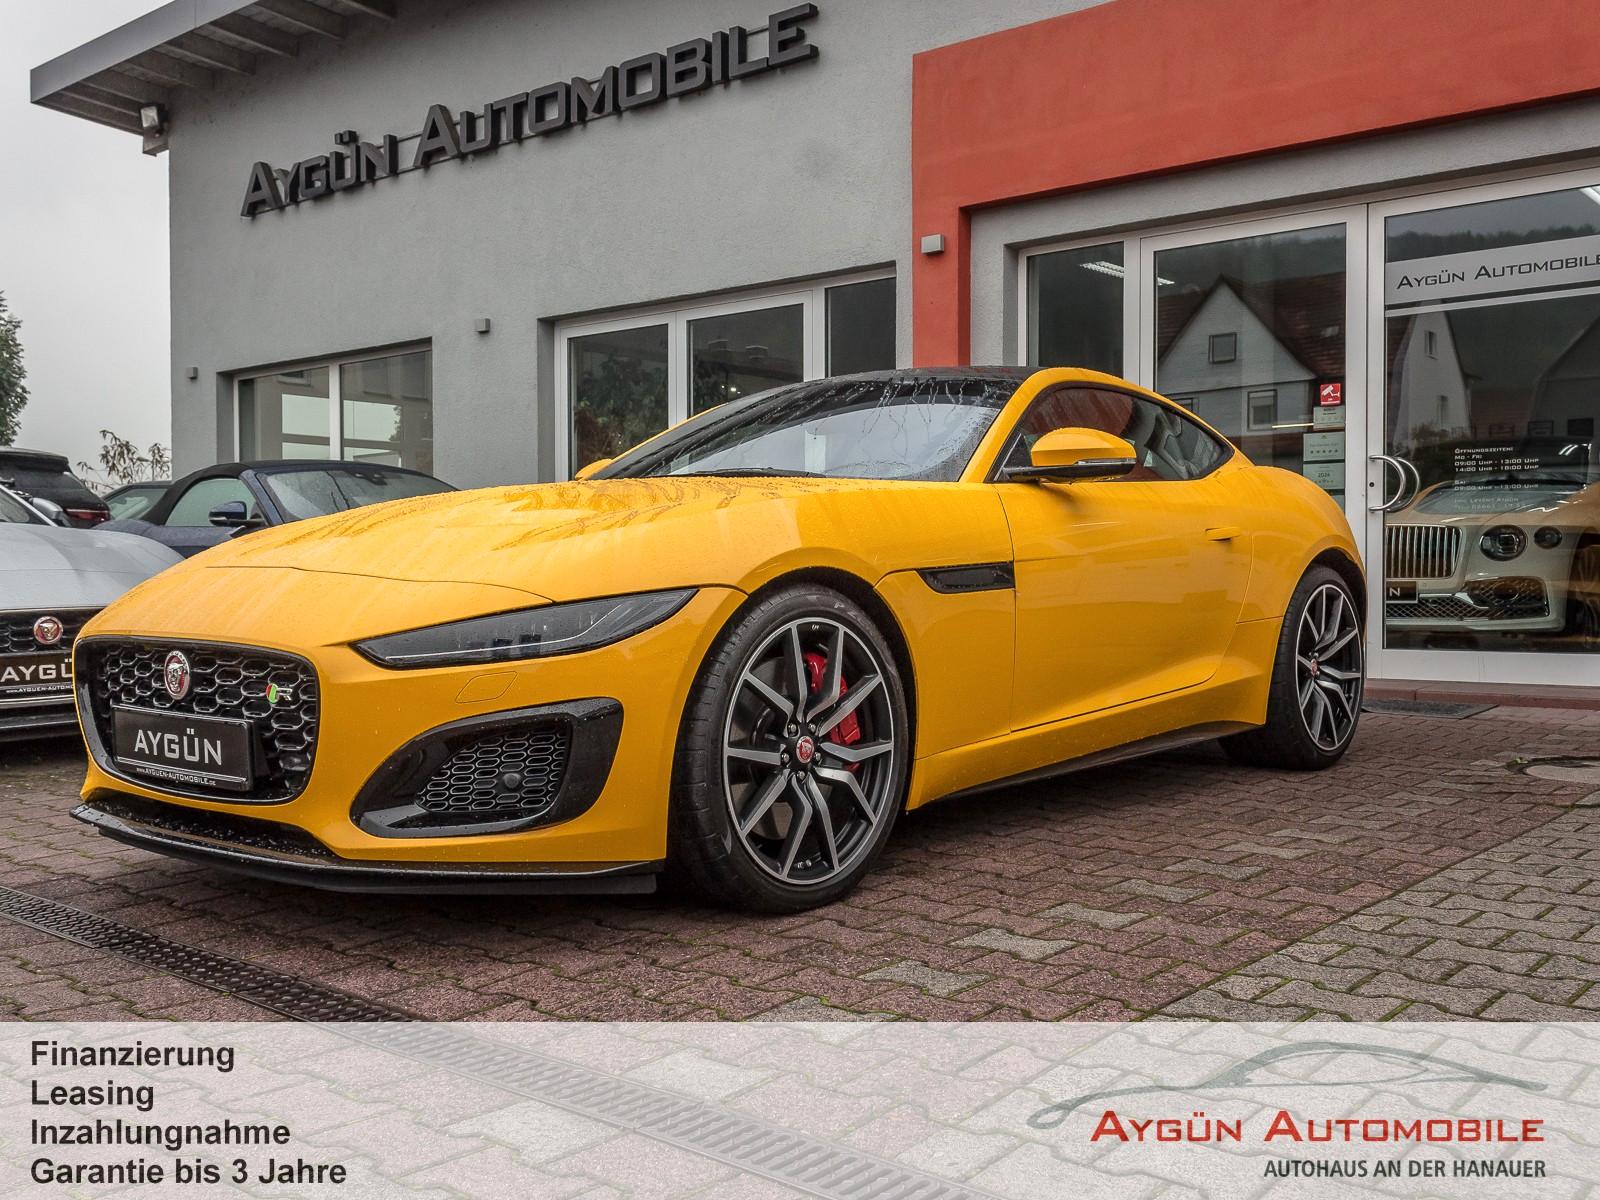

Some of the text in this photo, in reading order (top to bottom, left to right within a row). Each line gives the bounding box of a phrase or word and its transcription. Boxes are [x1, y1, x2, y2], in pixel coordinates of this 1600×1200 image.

[240, 2, 819, 217] AYGÜN AUTOMOBILE
[1397, 269, 1465, 290] AYGÜN
[134, 727, 222, 766] AYGÜN
